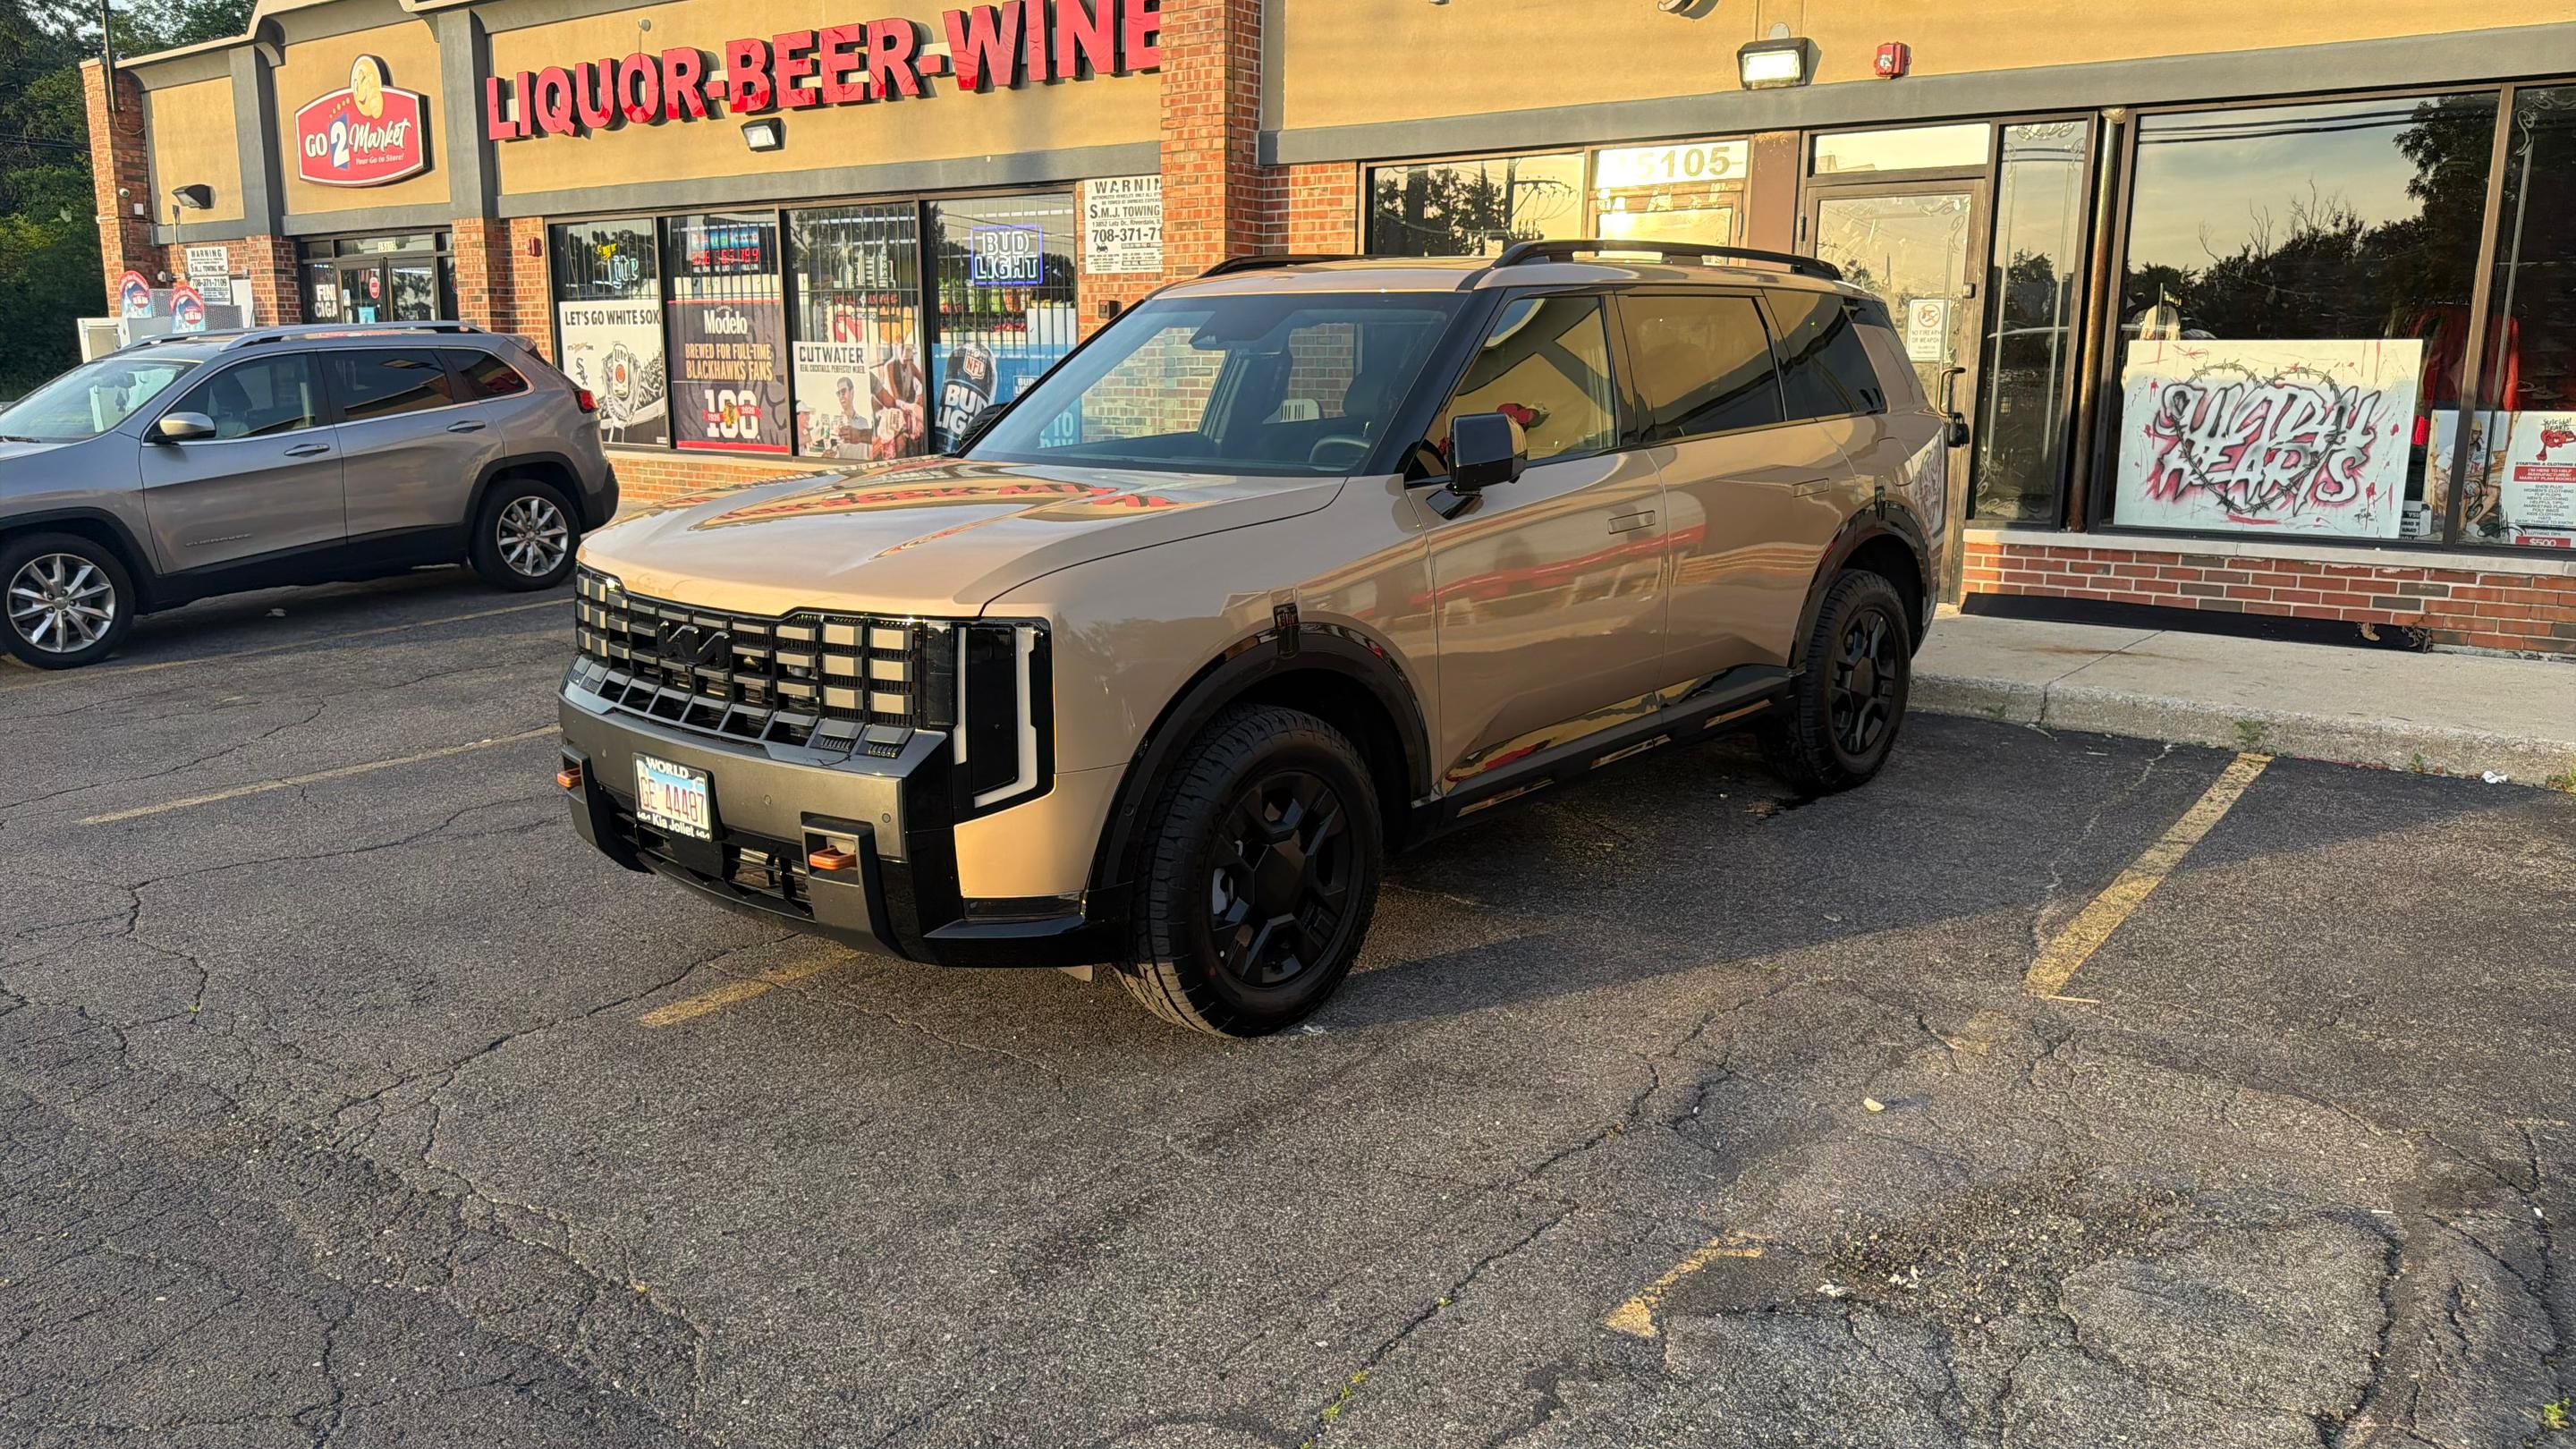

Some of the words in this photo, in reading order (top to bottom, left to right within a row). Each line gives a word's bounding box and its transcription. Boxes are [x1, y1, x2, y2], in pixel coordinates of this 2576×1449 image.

[305, 132, 328, 157] GO
[330, 121, 351, 168] 2
[348, 117, 411, 154] Market
[356, 157, 368, 165] Your
[369, 156, 377, 164] Go
[1089, 204, 1120, 219] S.M.J.
[1123, 204, 1160, 217] TOWING
[191, 249, 222, 258] WARNING
[982, 231, 1030, 256] BUD
[974, 255, 1038, 279] LIGHT
[565, 310, 589, 326] LET'S
[591, 309, 605, 326] GO
[606, 309, 638, 325] WHITE
[640, 309, 660, 325] SOX
[703, 309, 749, 335] Modelo
[685, 343, 715, 360] BREWED
[716, 343, 731, 360] FOR
[733, 343, 772, 360] FULL-TIME
[799, 346, 864, 364] CUTWATER
[686, 360, 746, 381] BLACKHAWKS
[749, 360, 773, 382] FANS
[965, 355, 985, 376] NFL
[935, 405, 974, 435] LIG
[2154, 436, 2369, 516] HEARTS
[2529, 538, 2557, 547] $500
[645, 756, 690, 779] WORLD
[652, 813, 668, 829] Kia
[669, 818, 695, 837] Joliet
